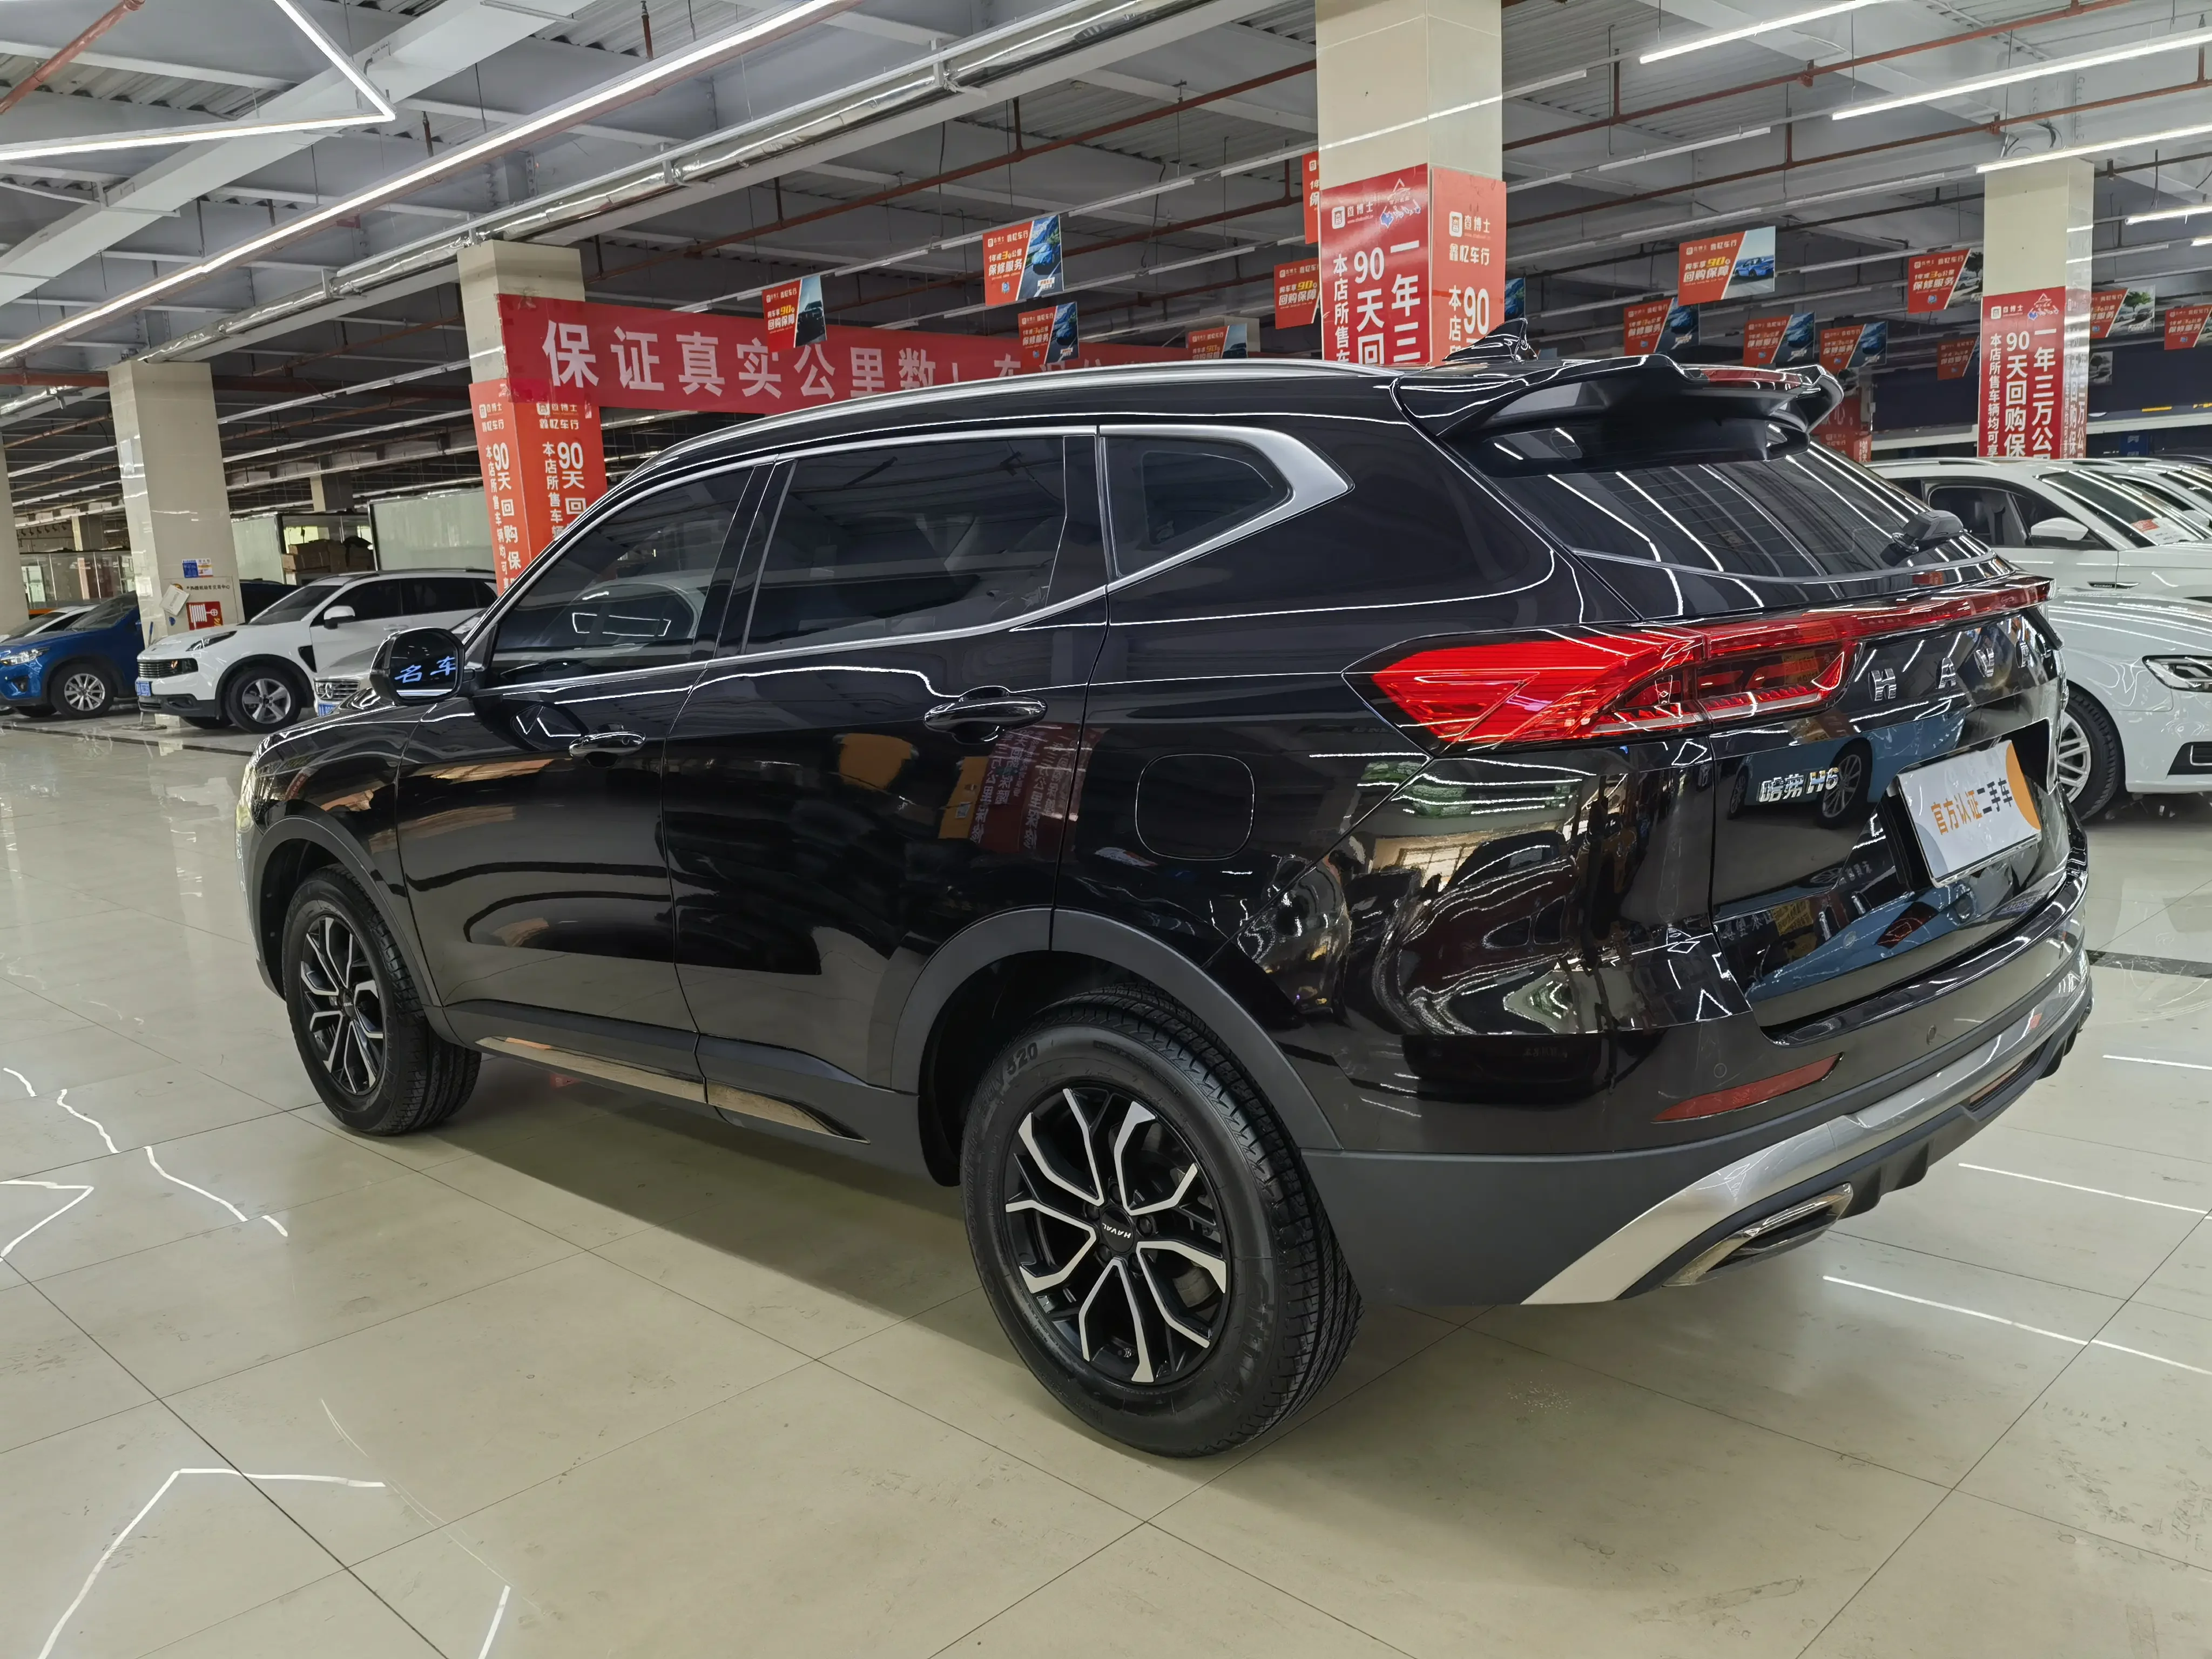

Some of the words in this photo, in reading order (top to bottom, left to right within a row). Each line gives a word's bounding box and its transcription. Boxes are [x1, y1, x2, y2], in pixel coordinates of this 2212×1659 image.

[988, 259, 1023, 276] 保修服务
[1464, 286, 1490, 346] 90
[2004, 331, 2030, 457] 90天回购保
[493, 442, 522, 584] 90天回购保
[1759, 773, 1804, 802] 哈弗
[1806, 767, 1839, 794] H6
[1931, 778, 2013, 835] 官方认证二手车
[1007, 1042, 1038, 1076] 520
[1102, 1222, 1131, 1238] HAVAL
